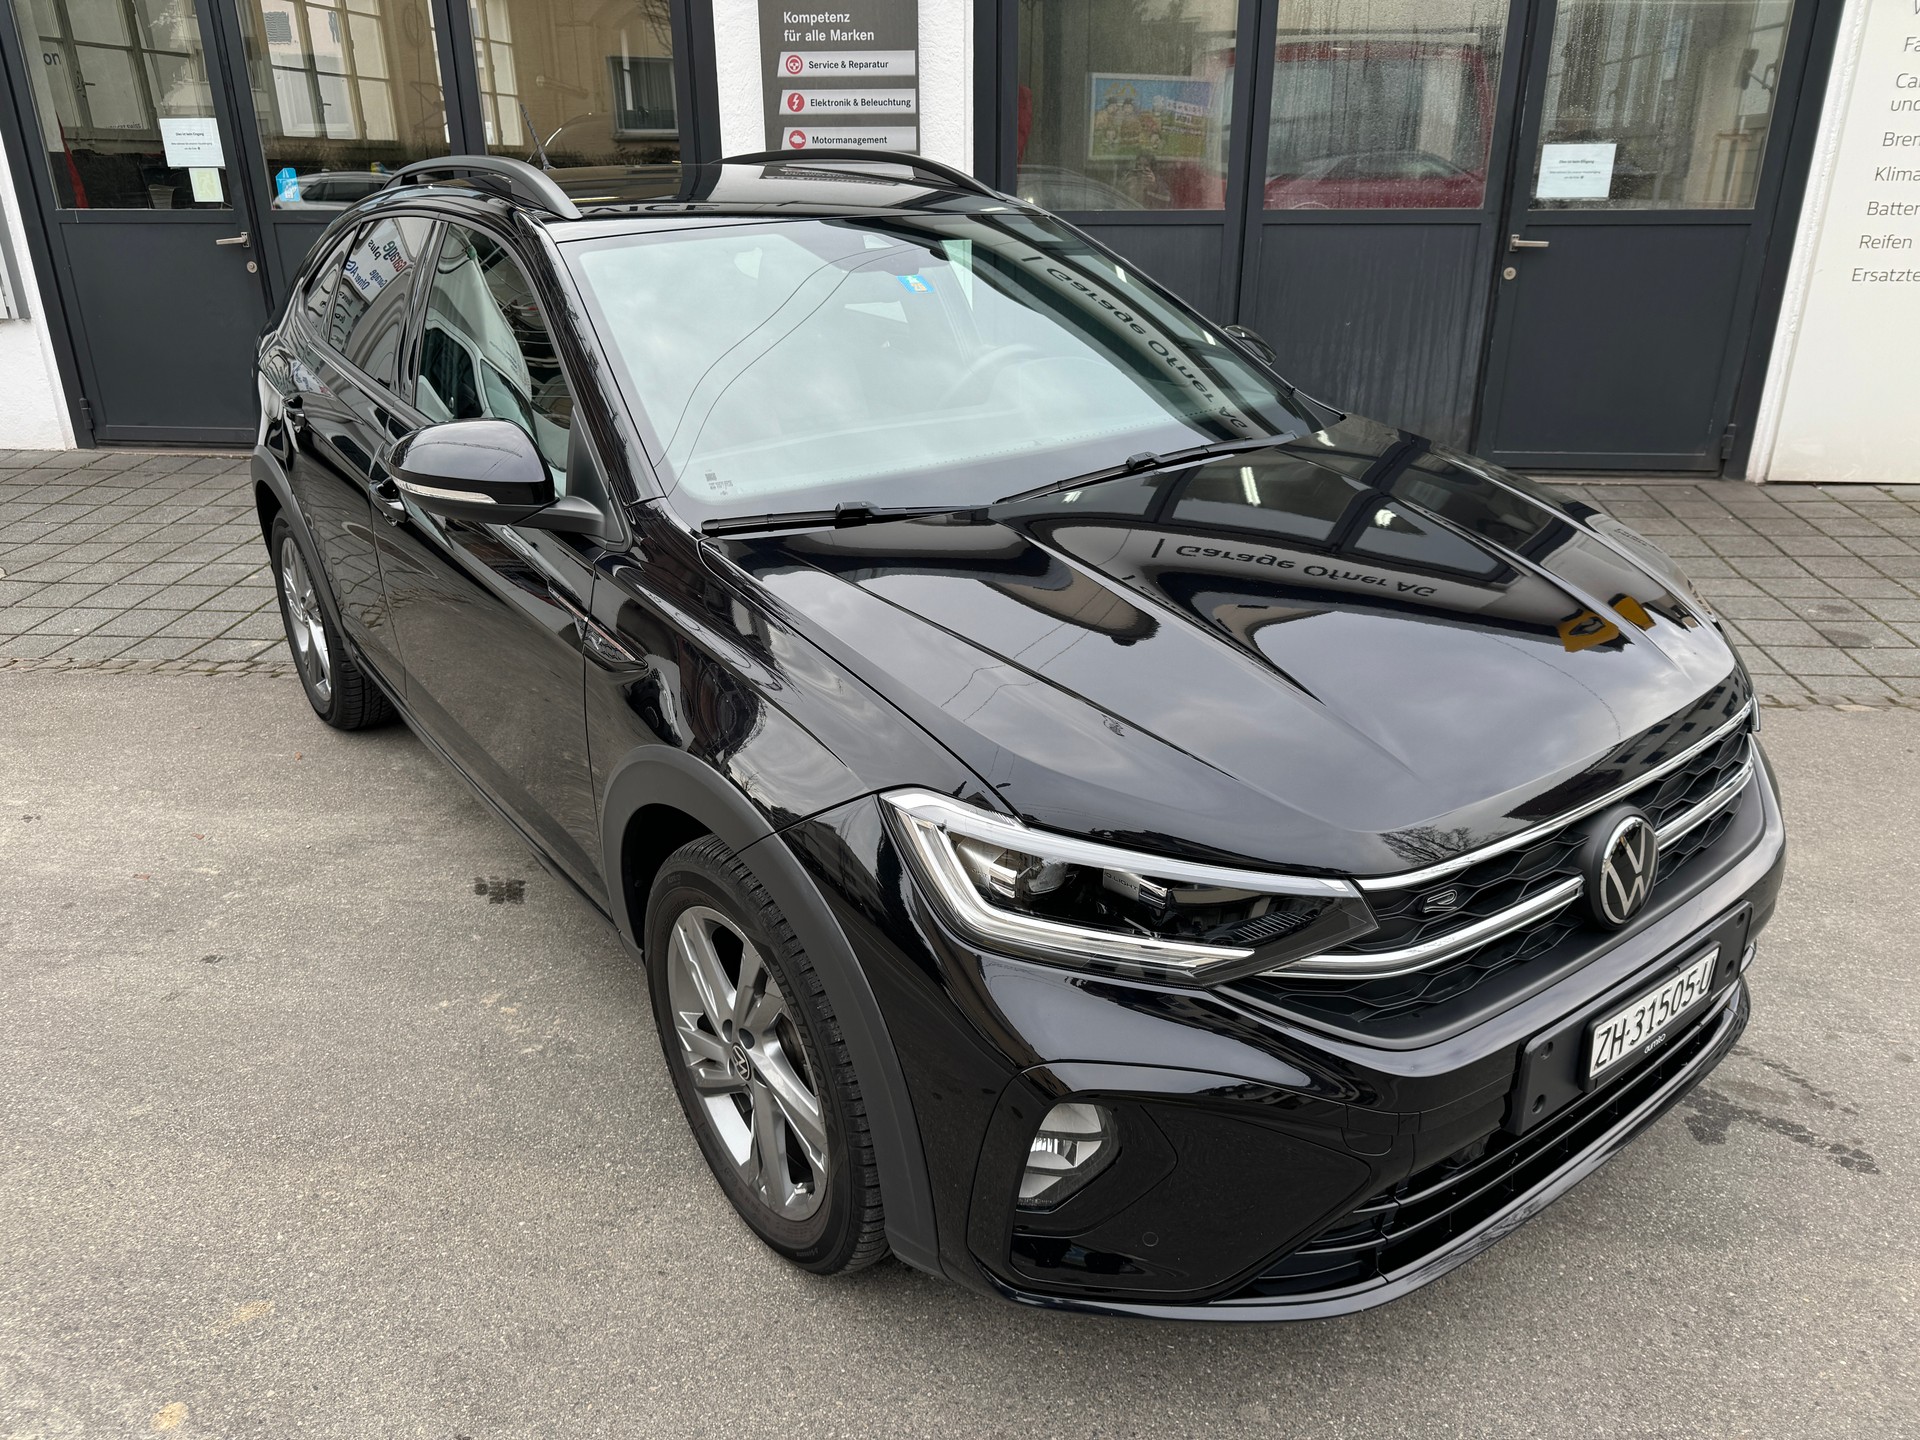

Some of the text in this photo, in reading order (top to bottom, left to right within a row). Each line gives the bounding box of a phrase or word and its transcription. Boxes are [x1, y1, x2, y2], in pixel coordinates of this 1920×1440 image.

[783, 11, 850, 25] Kompetenz
[784, 29, 875, 41] für alle Marken
[808, 60, 839, 69] Service
[848, 60, 889, 70] Reparatur
[1895, 72, 1920, 89] Ca
[810, 98, 851, 107] Elektronik
[860, 97, 911, 108] Beleuchtung
[811, 136, 888, 146] Motormanagement
[1858, 234, 1913, 249] Reifen
[1851, 267, 1920, 282] Ersatzte
